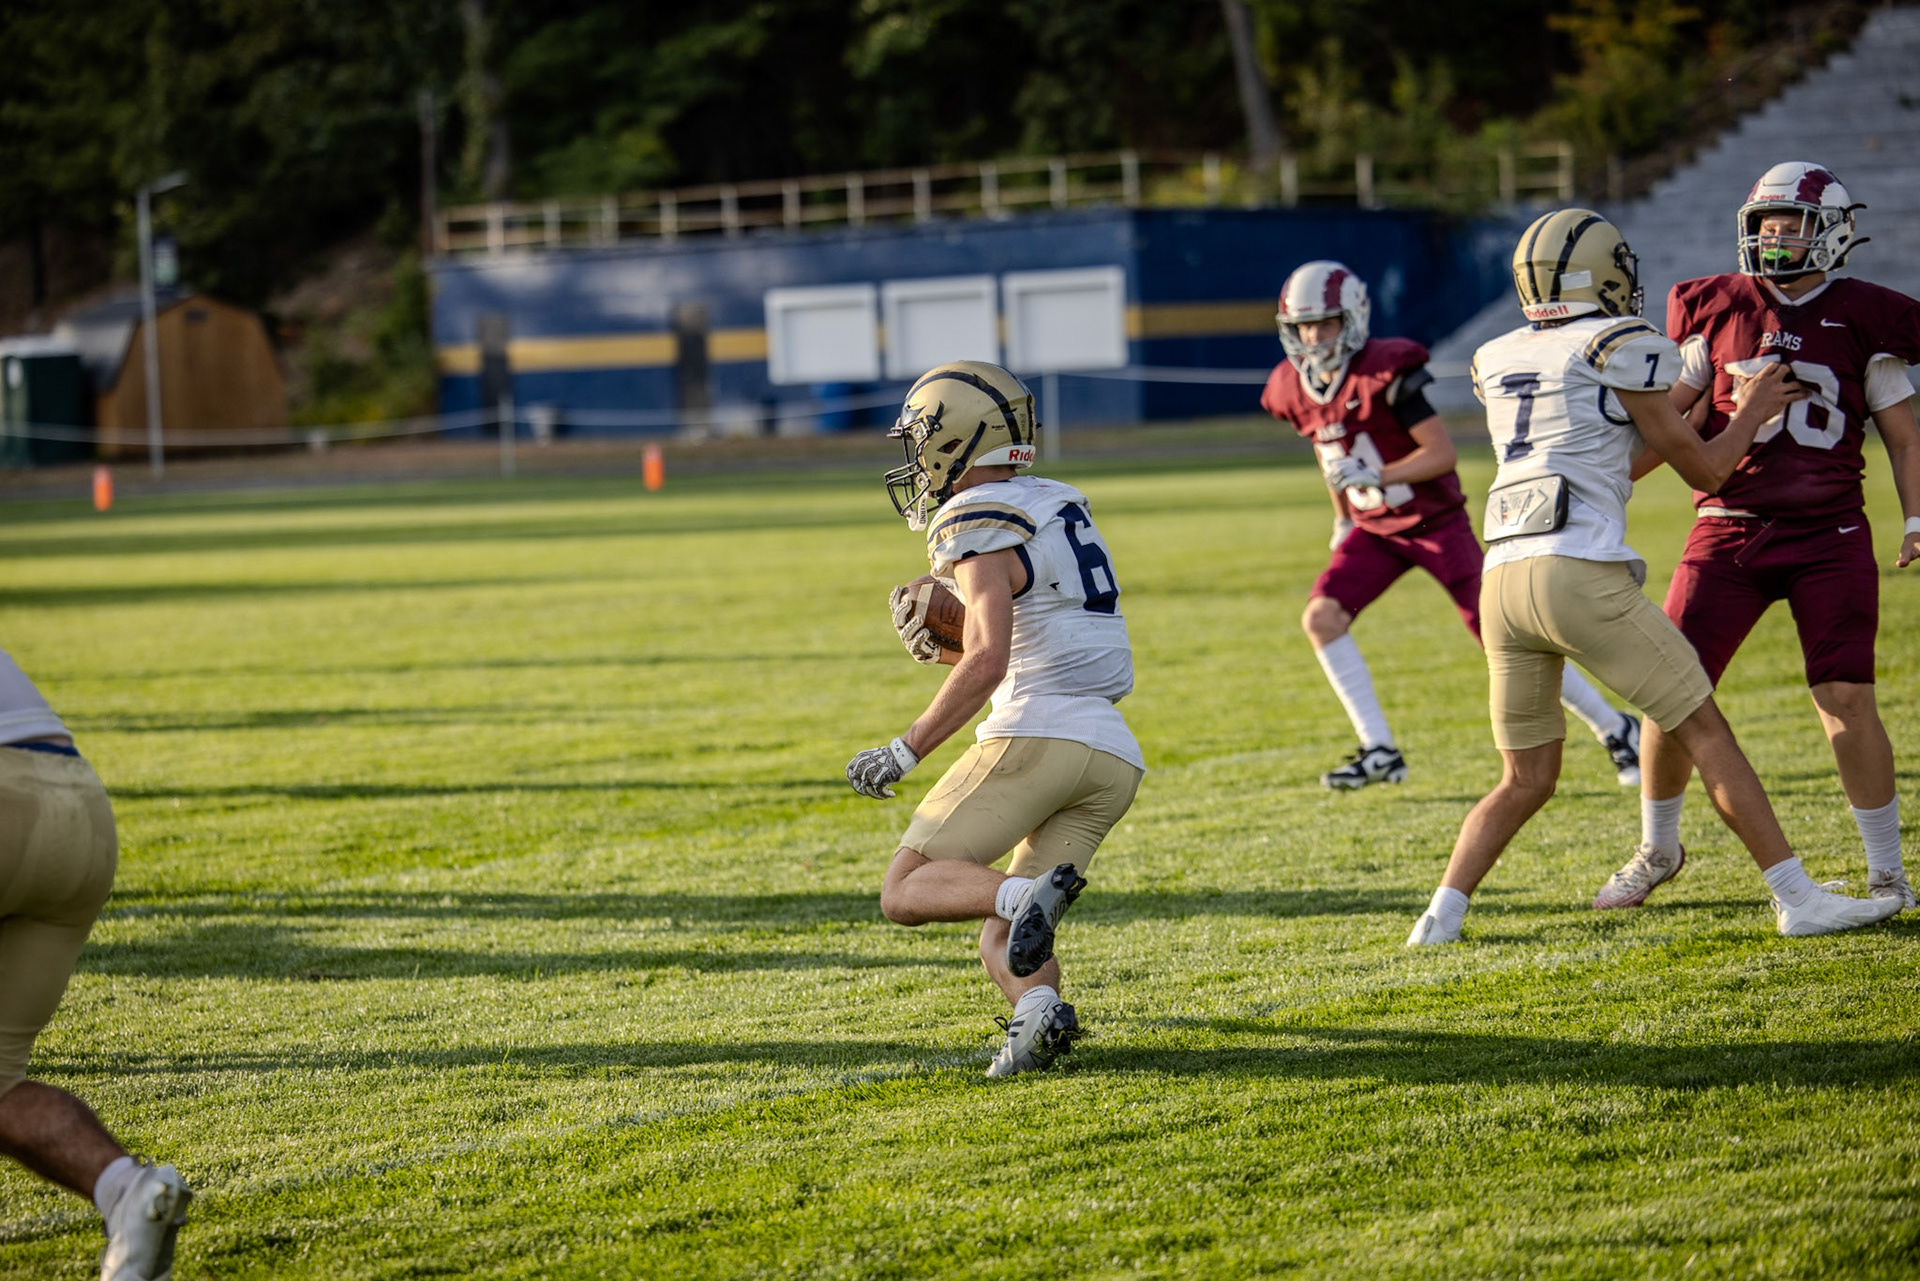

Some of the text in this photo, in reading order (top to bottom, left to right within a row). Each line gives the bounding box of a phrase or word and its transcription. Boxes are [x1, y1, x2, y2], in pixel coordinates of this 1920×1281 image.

[1643, 353, 1660, 388] 7
[1760, 330, 1802, 351] RAMS
[1500, 372, 1541, 462] 7
[1056, 502, 1119, 614] 6
